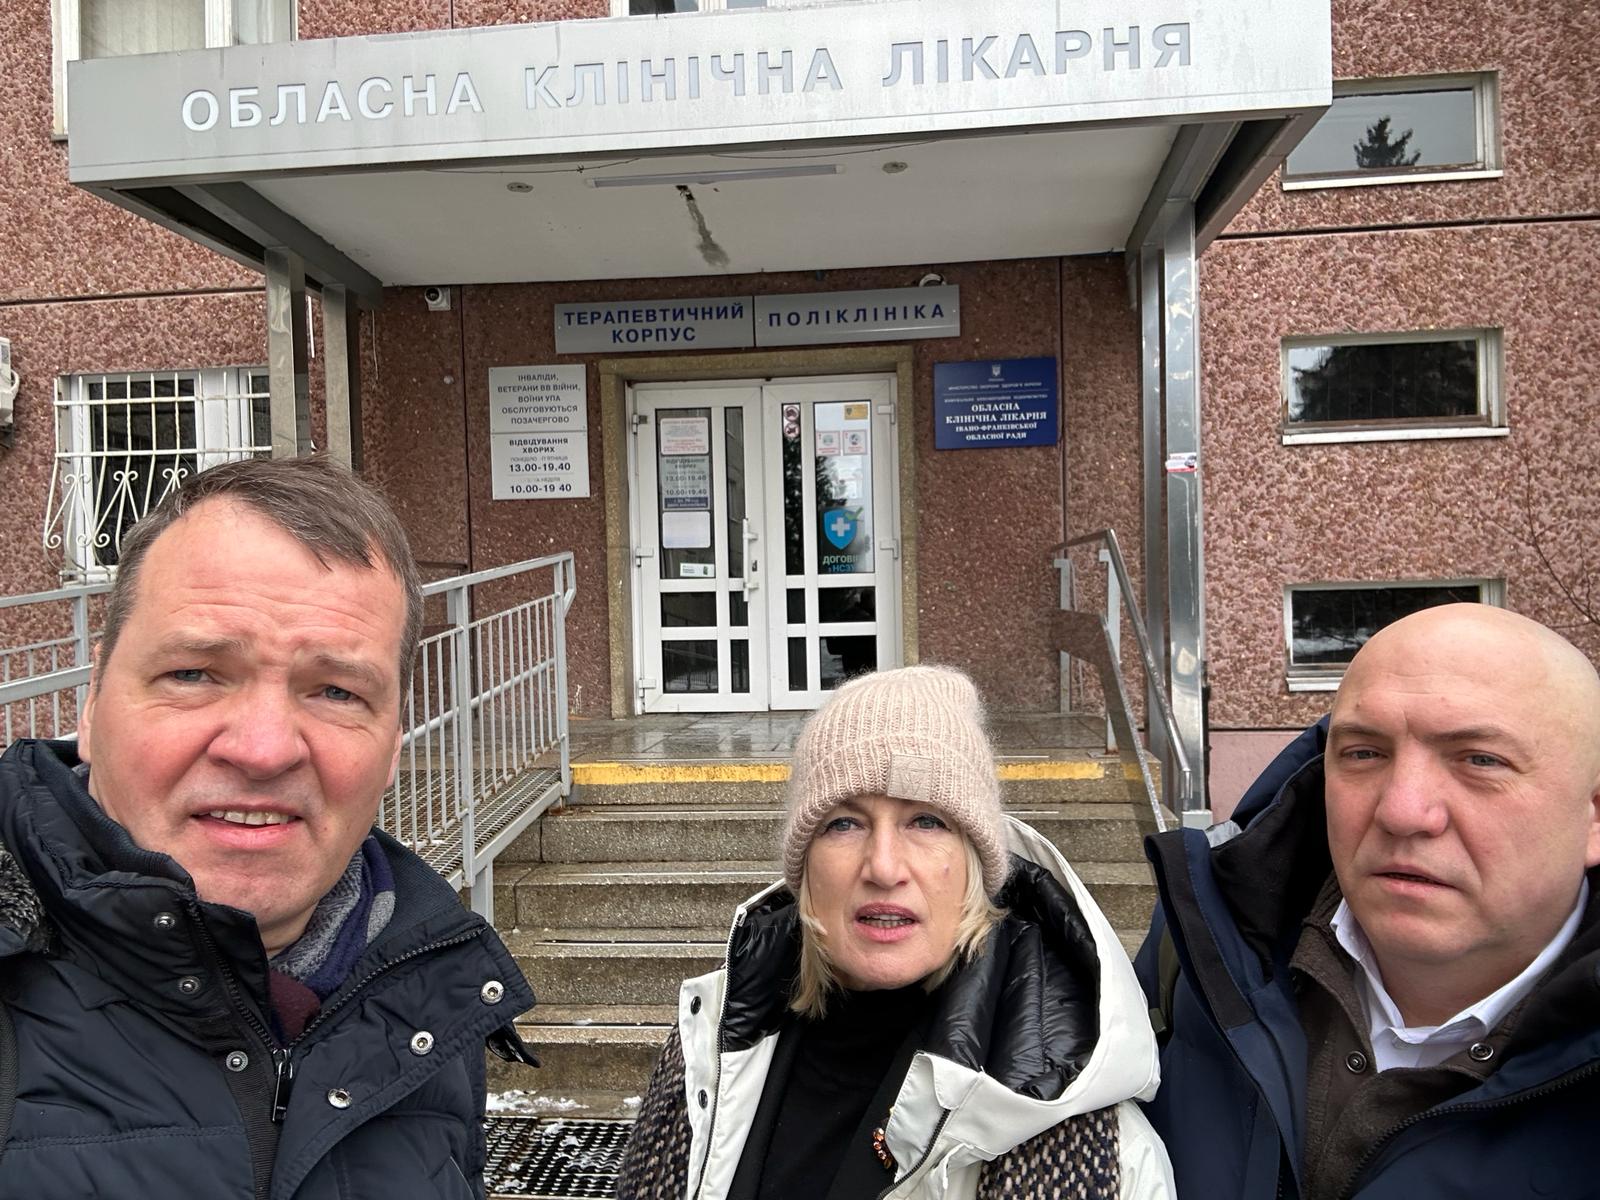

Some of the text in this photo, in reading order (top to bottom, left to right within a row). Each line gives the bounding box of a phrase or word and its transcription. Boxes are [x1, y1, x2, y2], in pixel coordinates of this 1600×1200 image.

[181, 22, 1191, 132] ОБЛАСНА КЛІНІЧНА ЛІКАРНЯ
[564, 302, 744, 326] ТЕРАПЕВТИЧНИЙ
[768, 304, 944, 327] ПОЛІКЛІНІКА
[612, 327, 696, 344] КОРПУС
[497, 384, 539, 393] ВЕТЕРАНИ
[545, 394, 561, 402] УПА
[502, 405, 578, 414] ОБСЛУГОВУЮТЬСЯ
[971, 402, 1020, 412] ОБЛАСНА
[511, 416, 570, 425] ПОЗАЧЕРГОВО
[945, 411, 1047, 424] КЛІНІЧНА ЛІКАРНЯ
[509, 438, 568, 446] ВІДВІДУВАННЯ
[510, 462, 571, 472] 13.00-19.40
